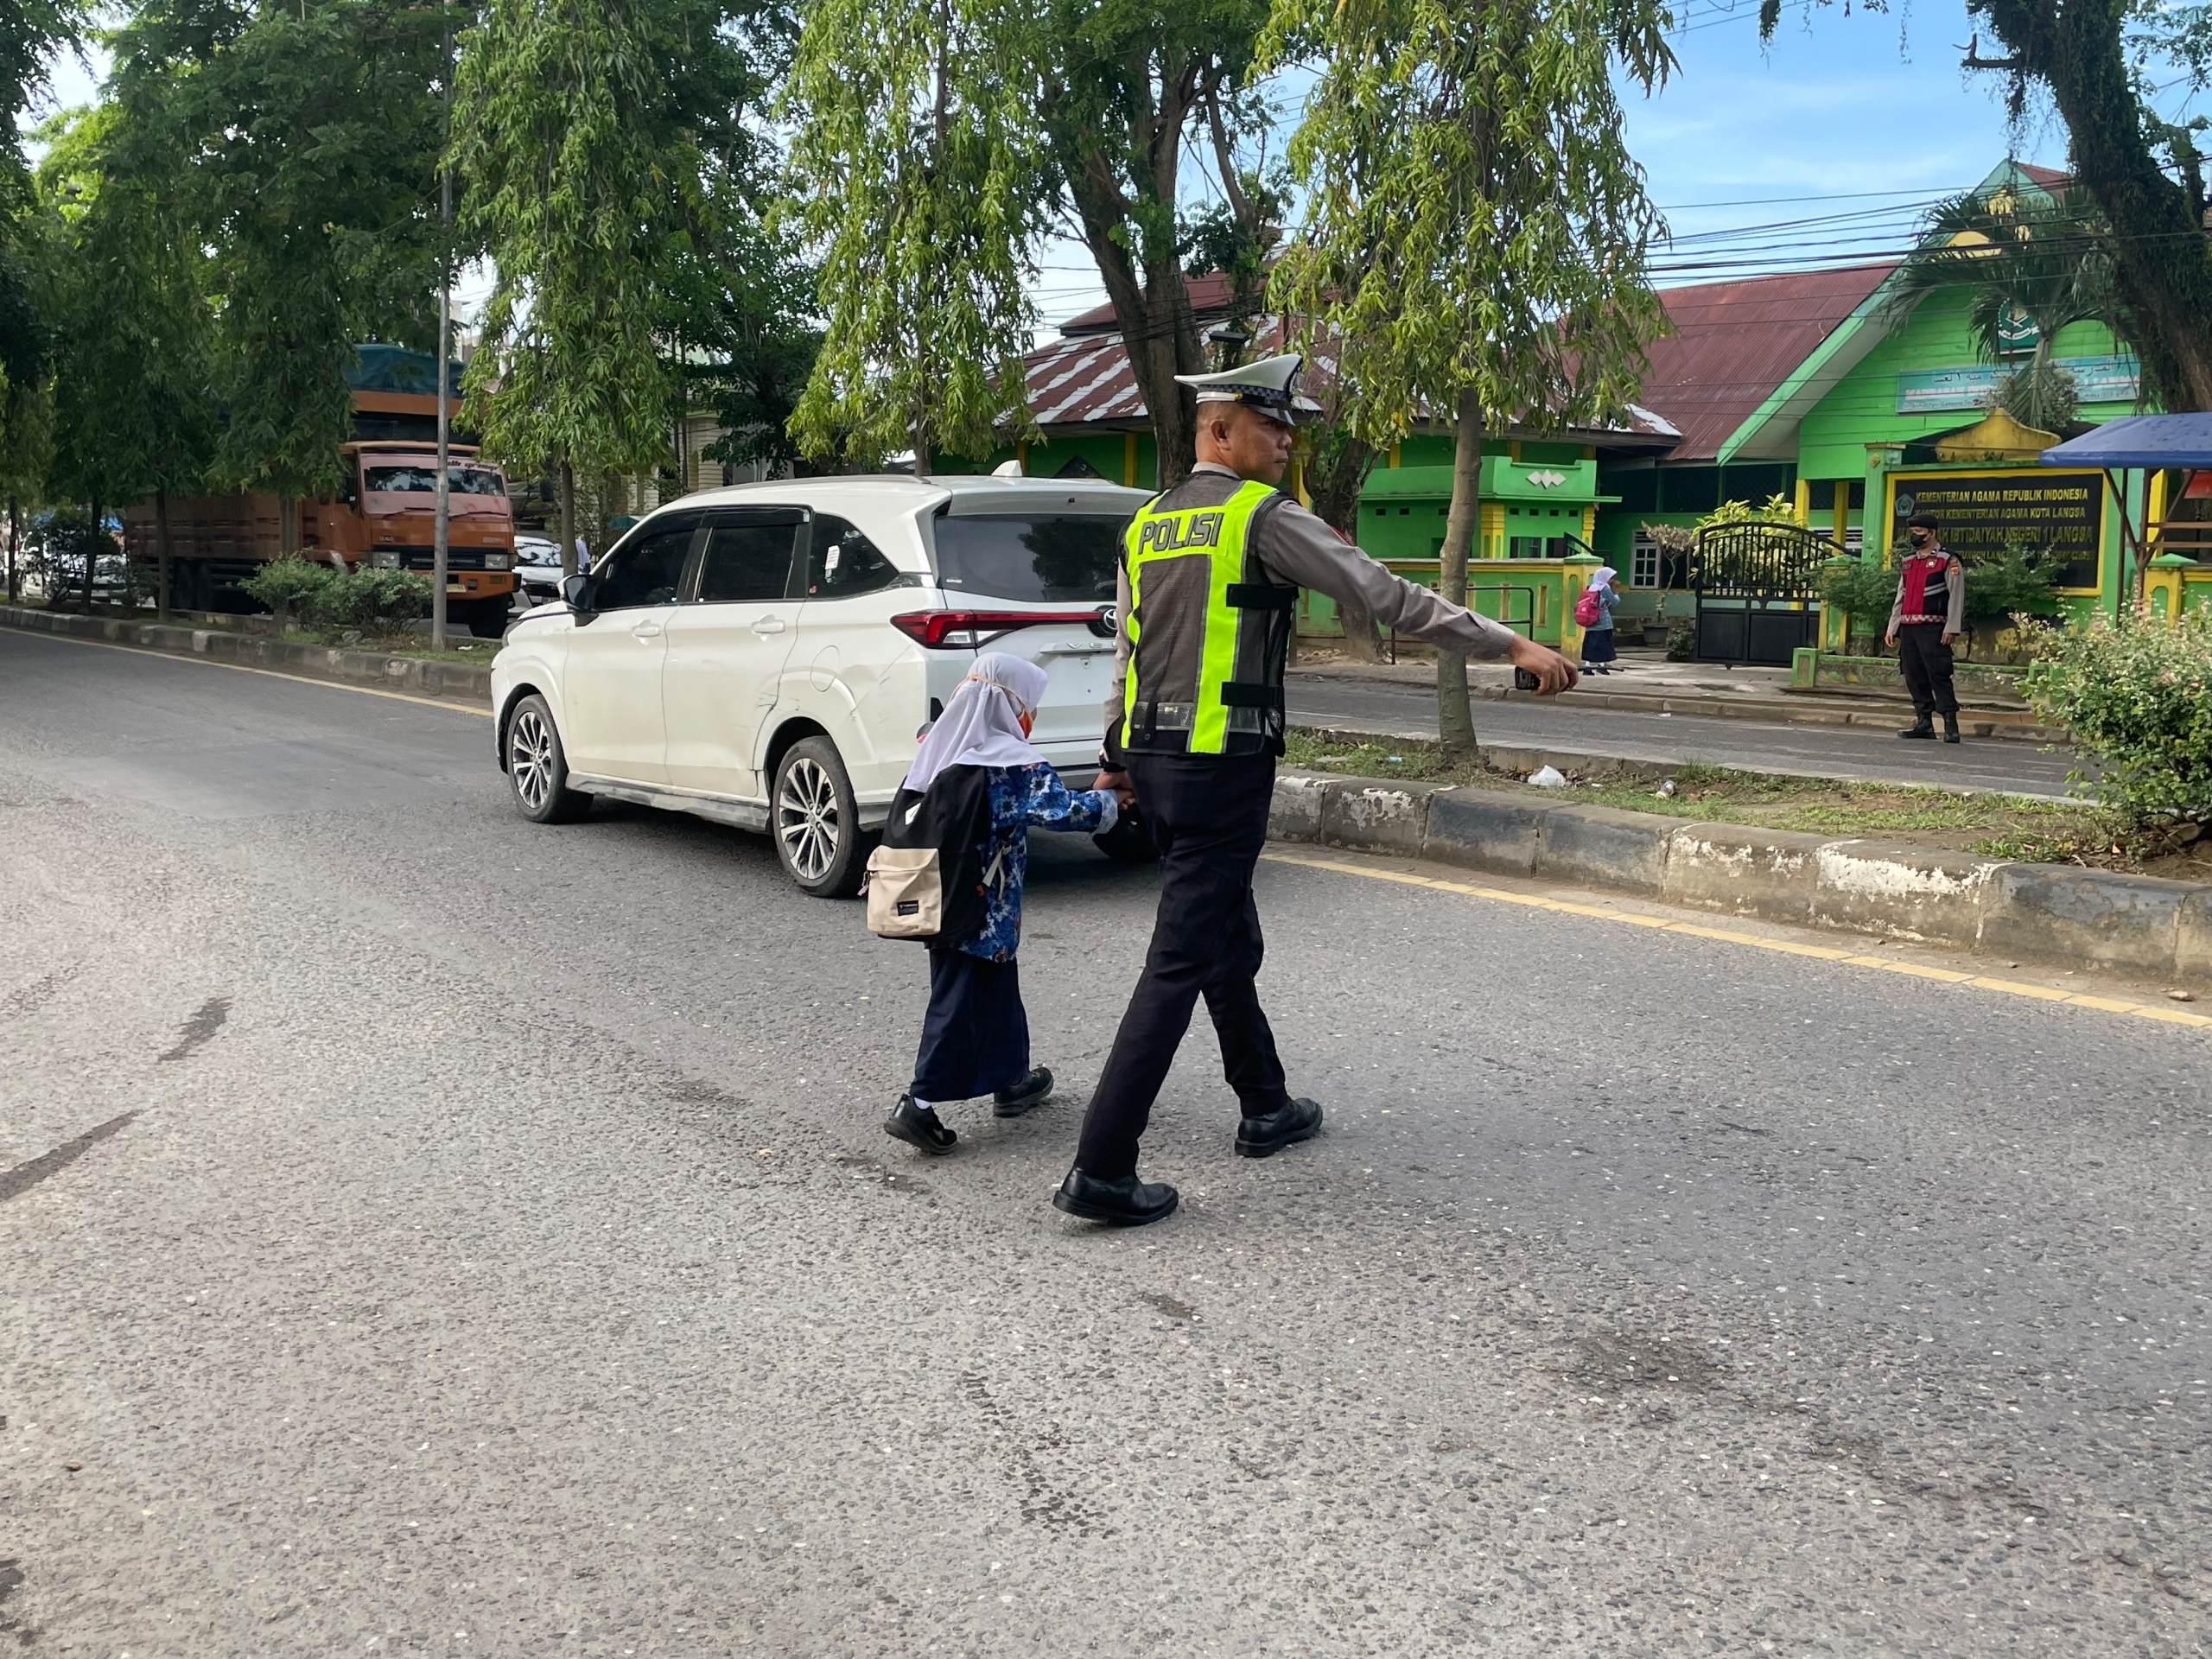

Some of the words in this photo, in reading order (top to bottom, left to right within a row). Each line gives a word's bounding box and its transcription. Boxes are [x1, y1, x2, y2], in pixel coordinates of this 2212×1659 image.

[1916, 490, 1970, 503] KEMENTERIAN
[1971, 489, 2001, 502] AGAMA
[2002, 489, 2043, 501] REPUBLIK
[2044, 488, 2088, 500] INDONESIA
[1946, 508, 1999, 520] KEMENTERIAN
[2000, 508, 2029, 519] AGAMA
[2030, 507, 2051, 519] KOTA
[2052, 506, 2086, 518] LANGSA
[1138, 512, 1225, 555] POLISI
[2004, 526, 2041, 543] NEGERI
[2044, 526, 2049, 543] 1
[2050, 525, 2093, 543] LANGSA
